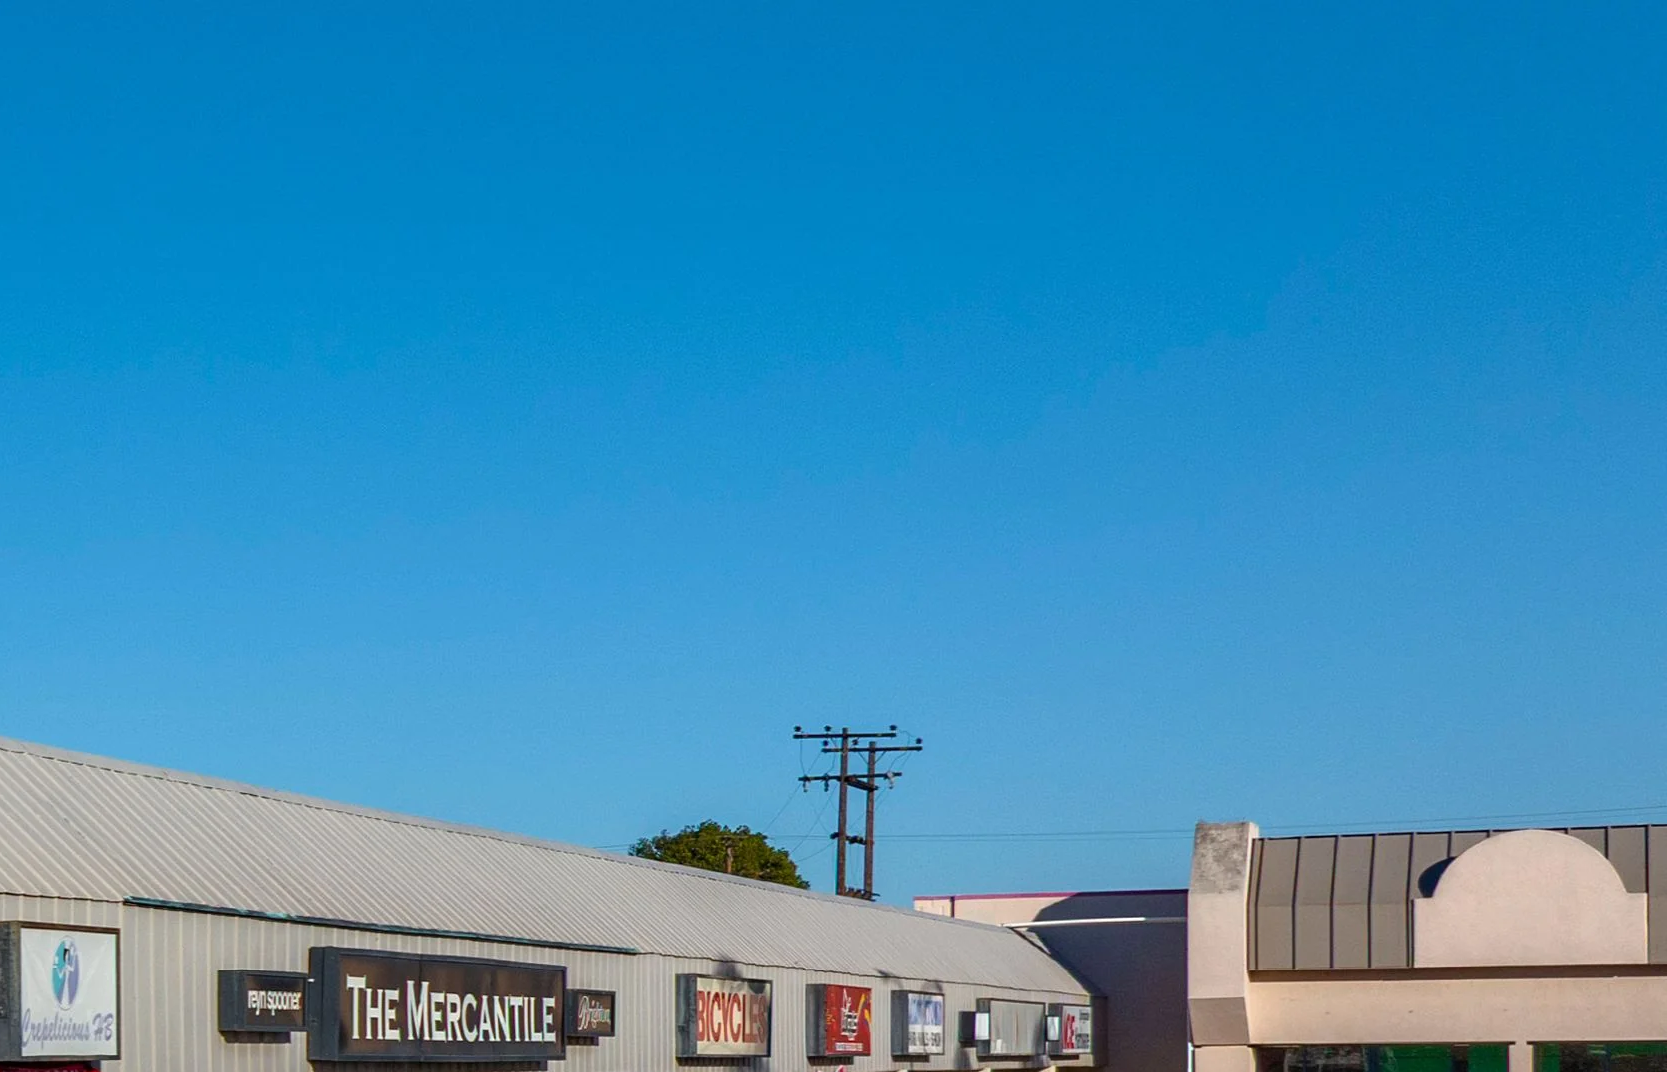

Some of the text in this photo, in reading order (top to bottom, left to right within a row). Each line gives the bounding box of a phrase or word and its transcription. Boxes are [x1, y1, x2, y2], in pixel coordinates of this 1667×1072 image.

[21, 1007, 114, 1050] Crepelicious HB
[407, 980, 557, 1043] MERCANTILE
[697, 990, 768, 1043] BICYCLES
